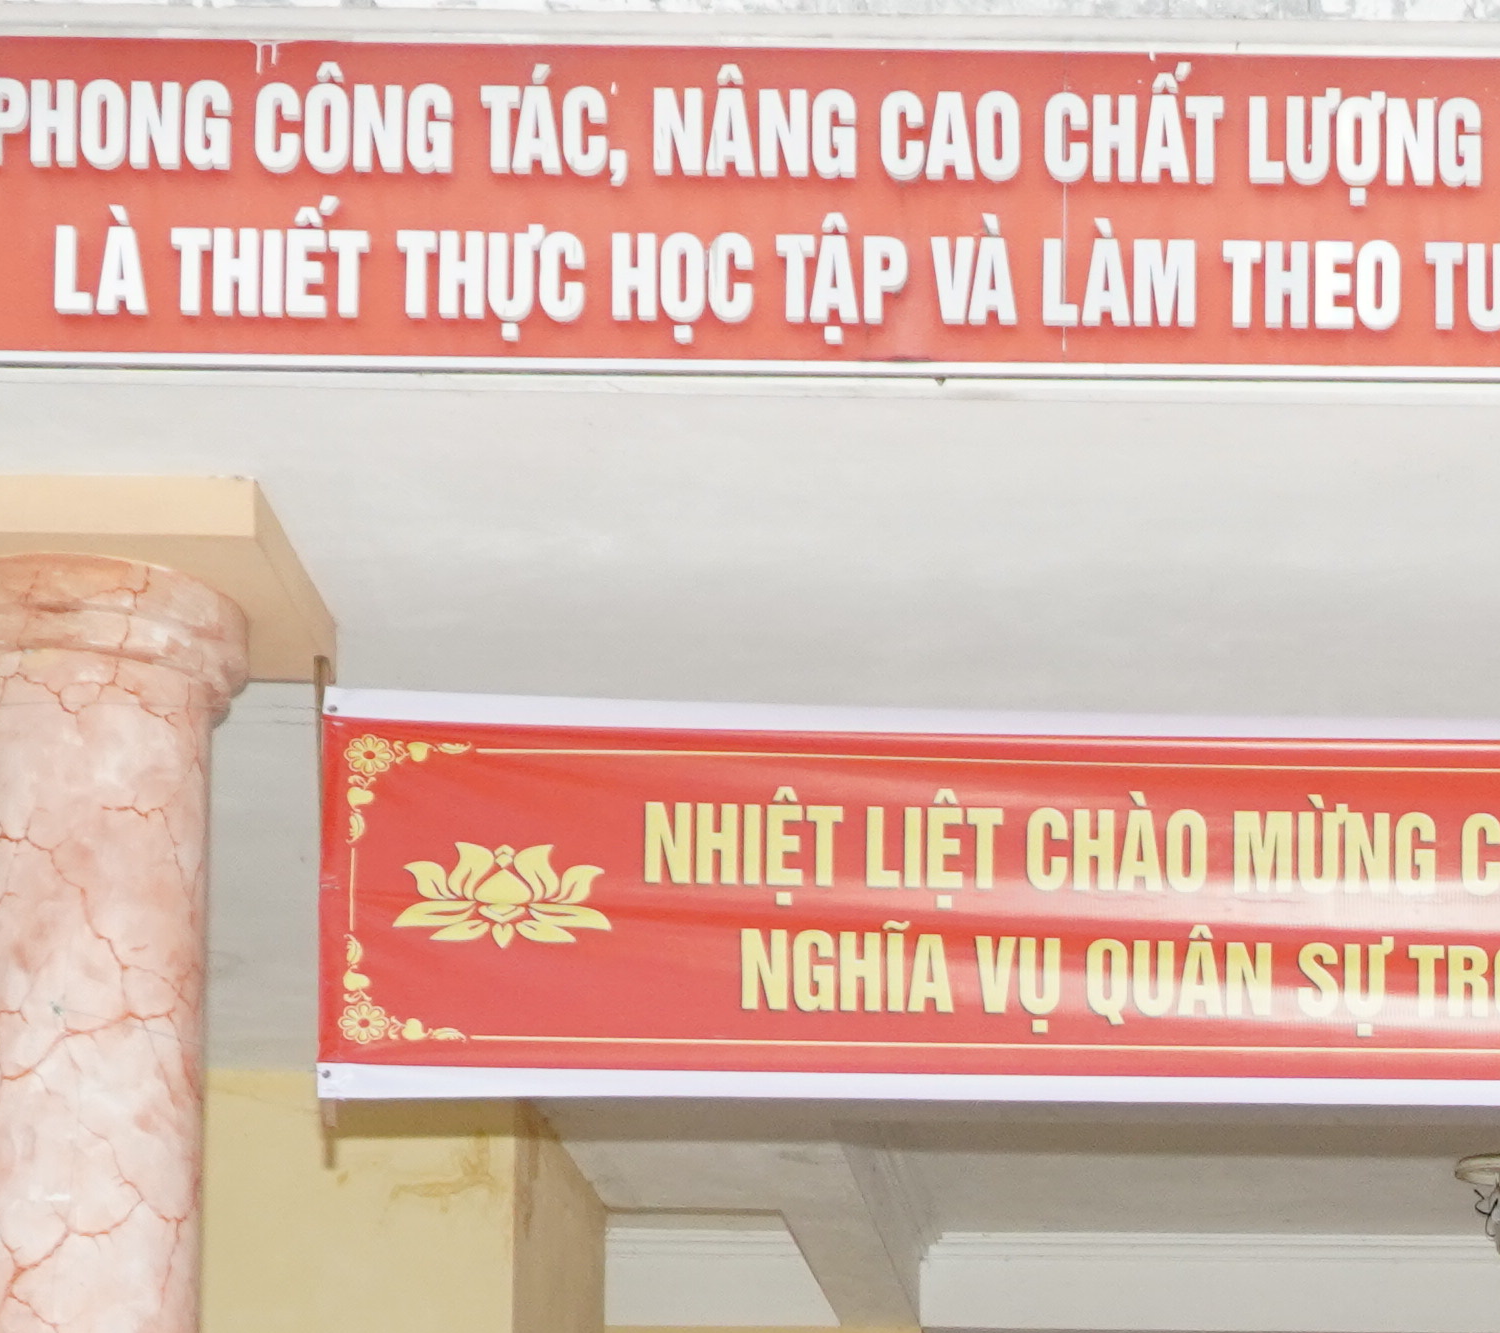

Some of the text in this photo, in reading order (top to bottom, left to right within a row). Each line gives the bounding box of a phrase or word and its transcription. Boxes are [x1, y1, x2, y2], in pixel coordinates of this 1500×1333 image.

[254, 61, 452, 176] CÔNG
[480, 63, 627, 187] TÁC,
[652, 63, 858, 177] NÂNG
[879, 90, 1021, 182] CAO
[1044, 61, 1225, 185] CHẤT
[1249, 87, 1482, 207] LƯỢNG
[53, 204, 149, 316] LÀ
[170, 195, 370, 320] THIẾT
[397, 223, 585, 342] THỰC
[610, 231, 754, 344] HỌC
[776, 212, 909, 345] TẬP
[930, 213, 1018, 327] VÀ
[1042, 217, 1197, 329] LÀM
[1223, 237, 1401, 330] THEO
[645, 785, 844, 906] NHIỆT
[866, 788, 1004, 908] LIỆT
[1026, 790, 1207, 893] CHÀO
[1231, 794, 1436, 898] MỪNG
[741, 919, 952, 1014] NGHĨA
[974, 936, 1061, 1033] VỤ
[1086, 924, 1272, 1026] QUÂN
[1298, 935, 1395, 1037] SỰ
